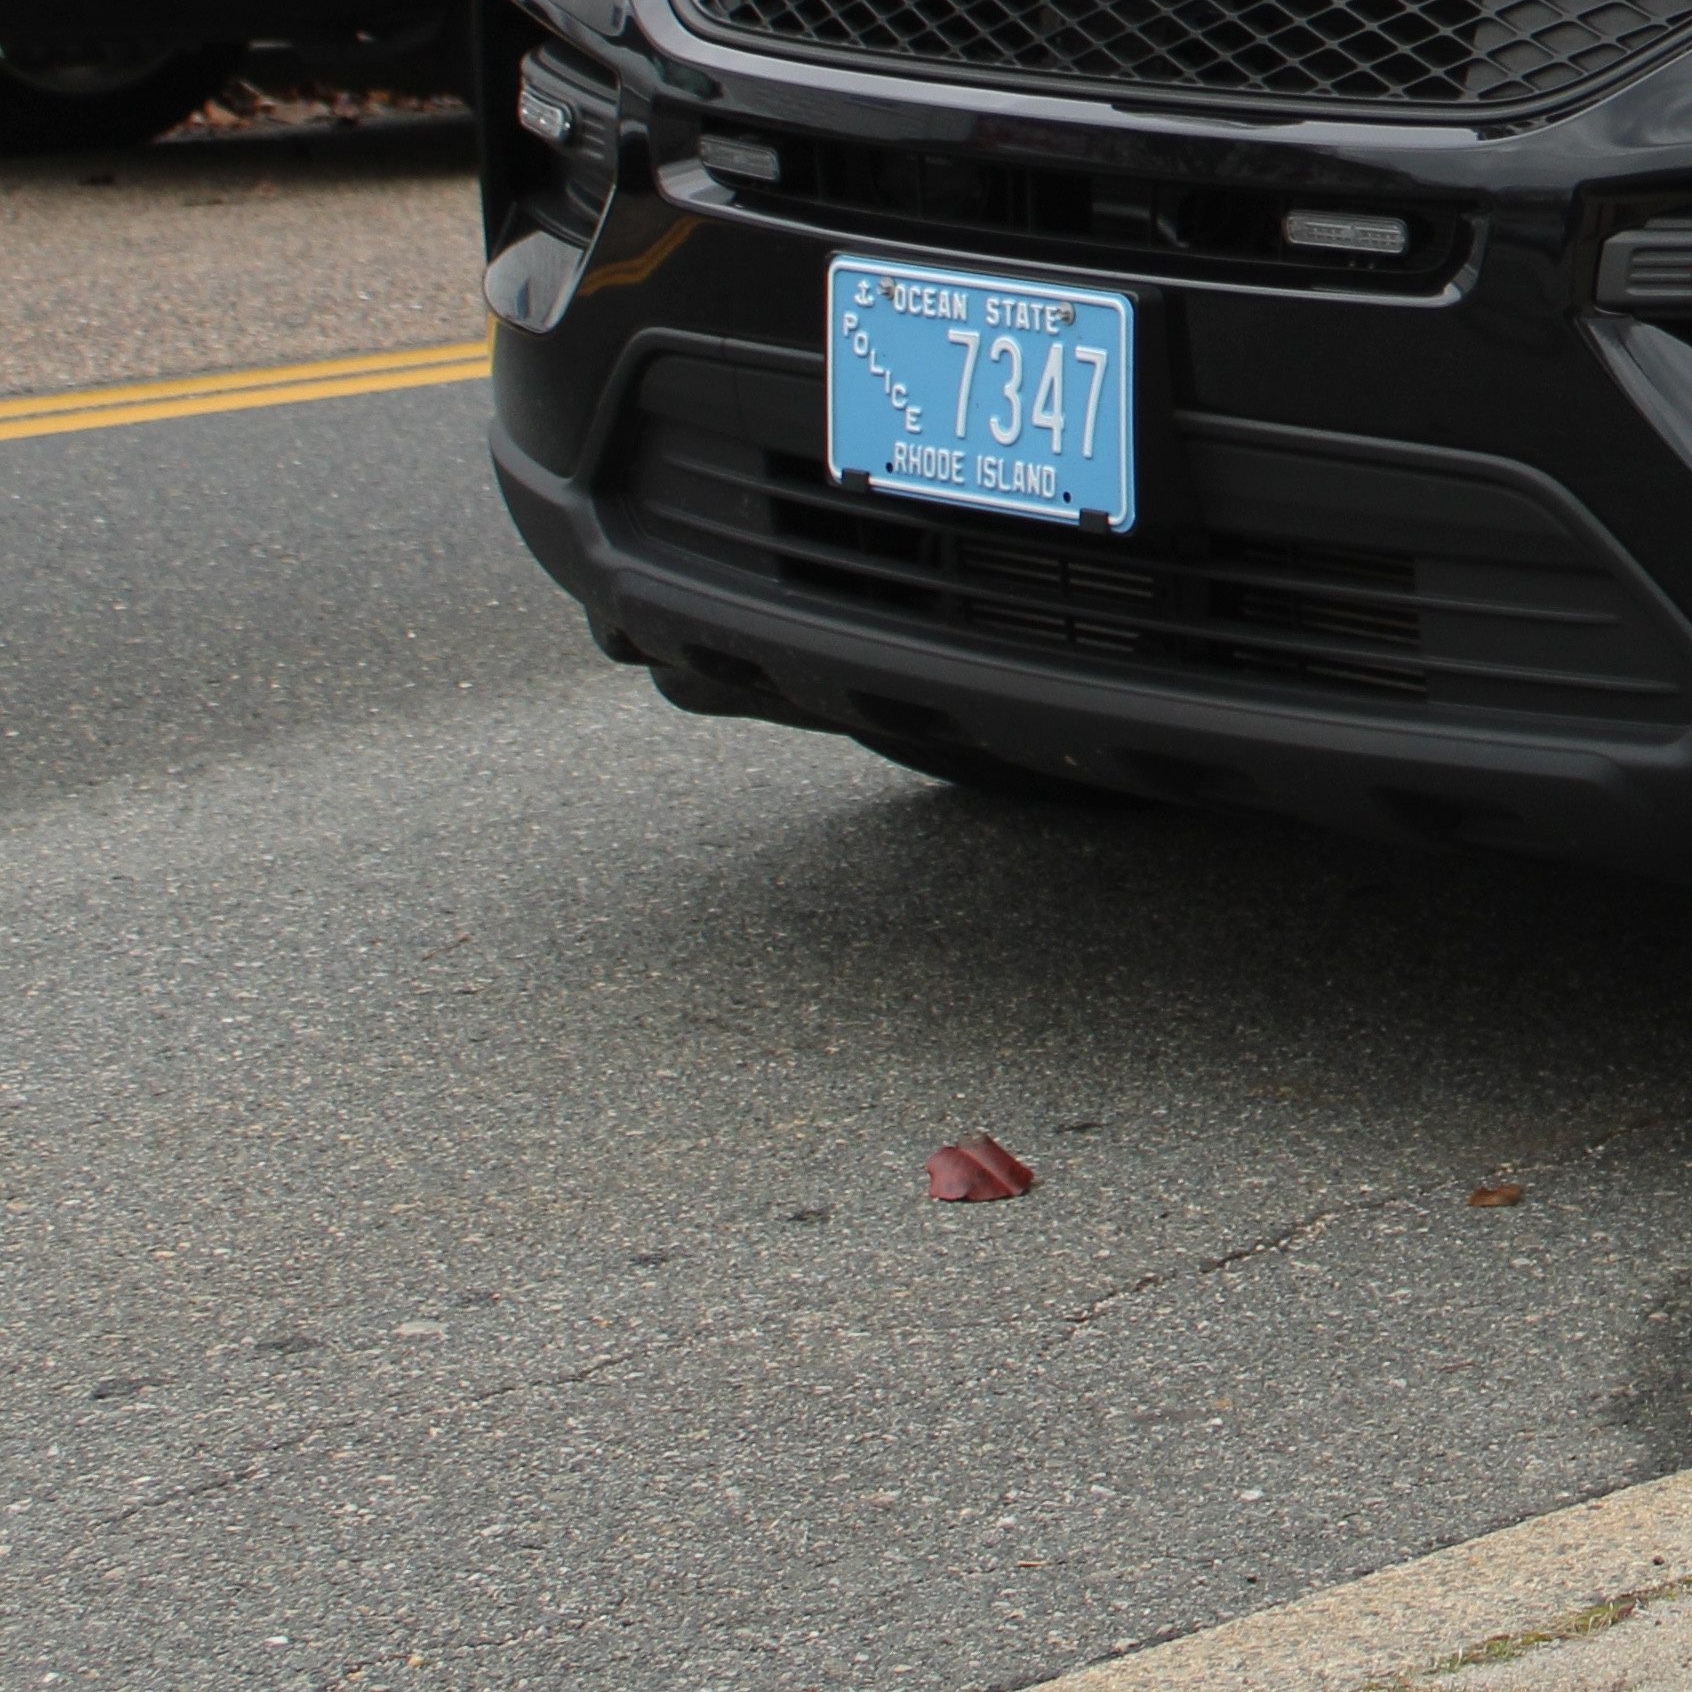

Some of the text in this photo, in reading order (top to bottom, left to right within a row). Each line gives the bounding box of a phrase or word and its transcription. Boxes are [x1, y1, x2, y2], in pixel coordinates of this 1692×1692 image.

[893, 284, 1060, 335] OCEAN STATE
[842, 312, 923, 434] POLICE
[946, 328, 1108, 459] 7347
[893, 442, 1056, 498] RHODE ISLAND
